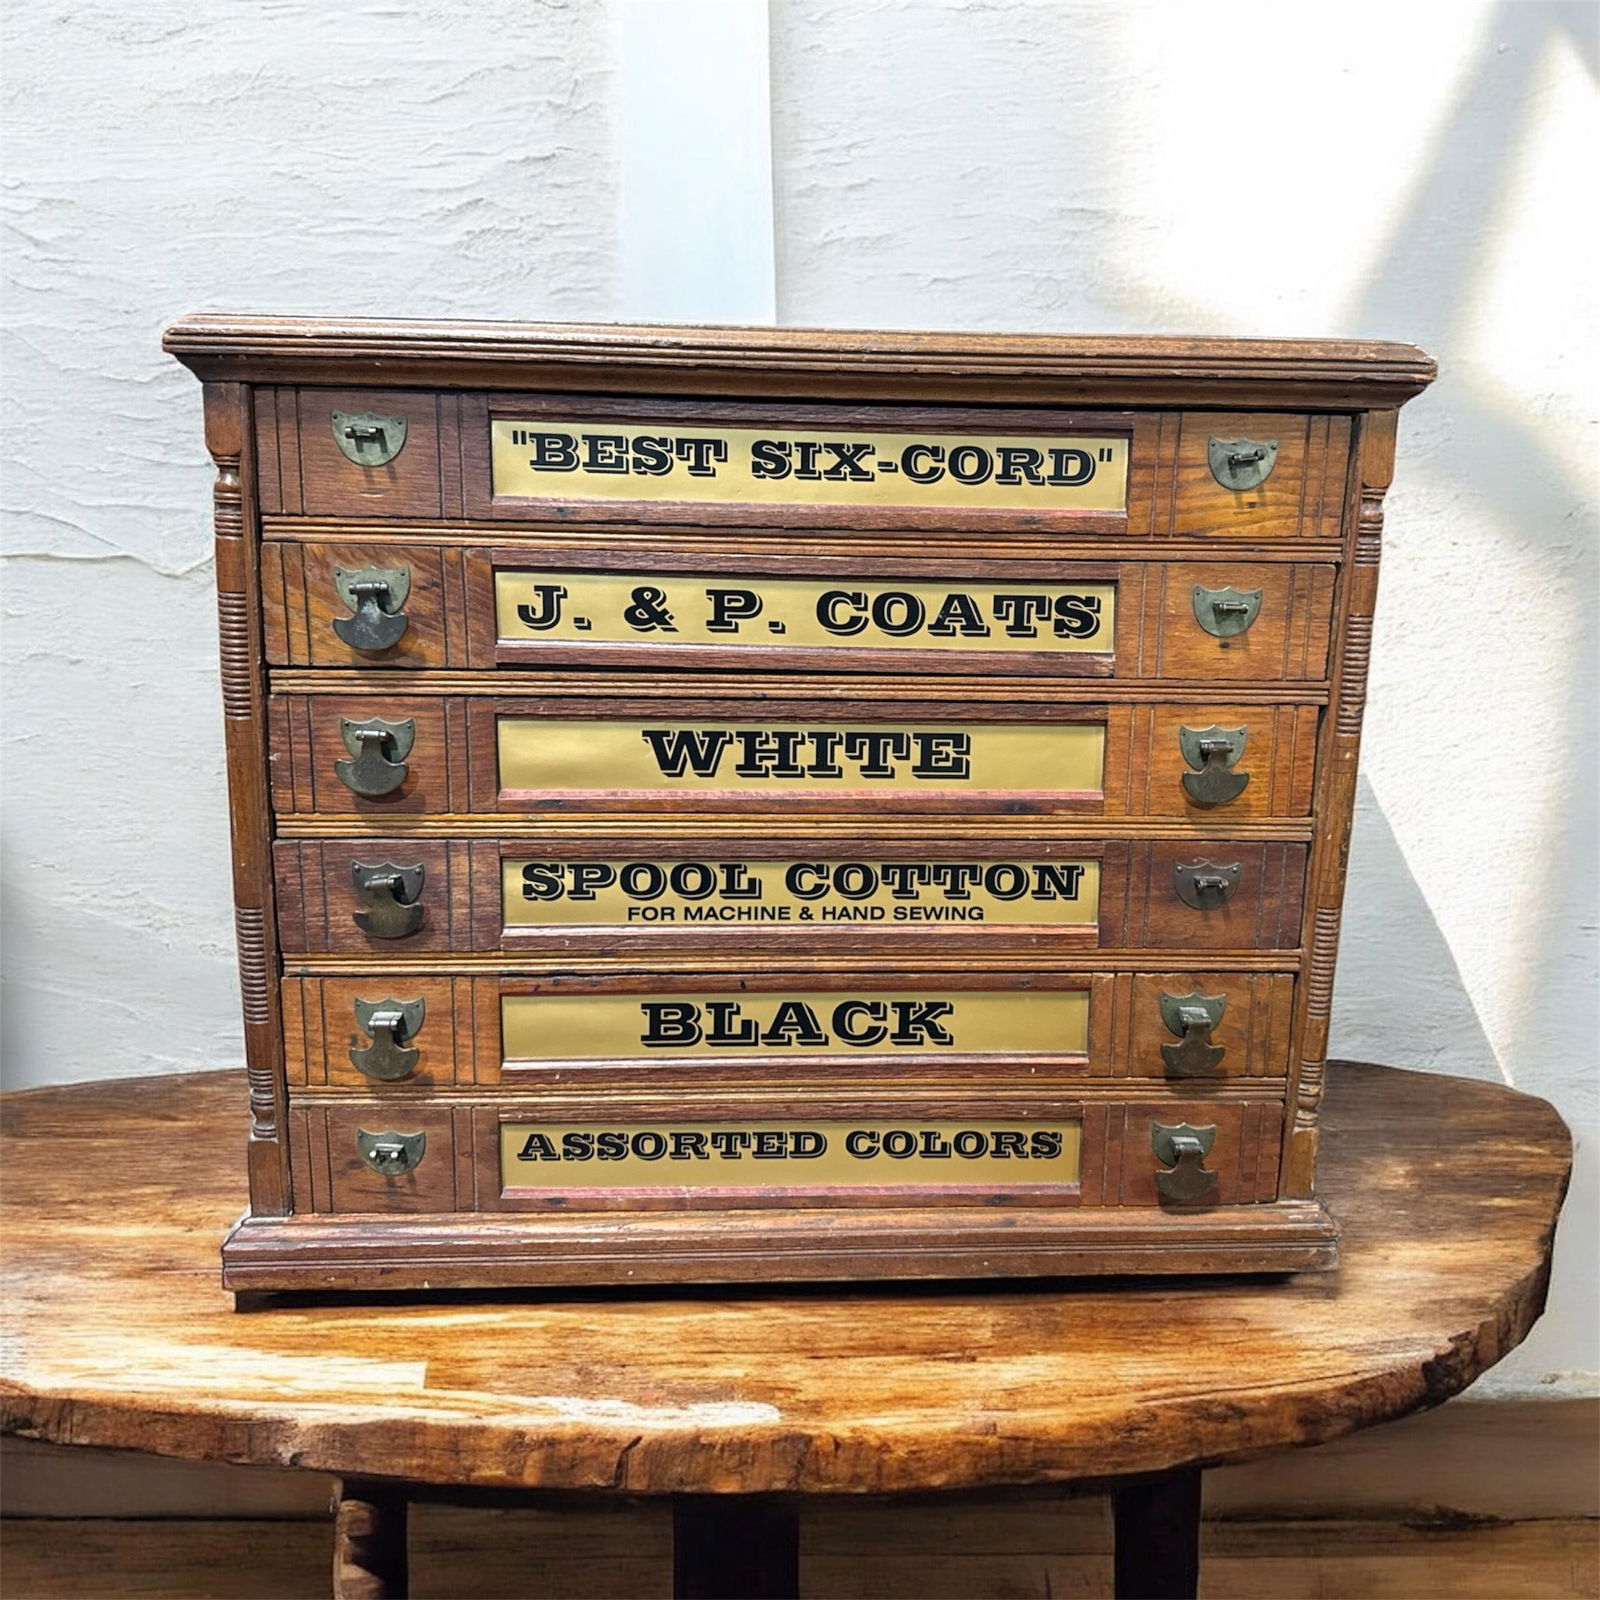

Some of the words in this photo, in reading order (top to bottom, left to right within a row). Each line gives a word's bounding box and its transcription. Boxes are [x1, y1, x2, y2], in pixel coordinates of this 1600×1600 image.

[512, 430, 728, 478] "BEST
[751, 439, 1113, 487] SIX-CORD"
[517, 585, 592, 631] J.
[623, 586, 679, 633] &
[705, 589, 786, 634] P.
[816, 590, 1102, 640] COATS
[641, 729, 971, 780] WHITE
[522, 862, 763, 902] SPOOL
[785, 862, 1086, 902] COTTON
[627, 906, 676, 921] FOR
[684, 906, 791, 921] MACHINE
[798, 906, 814, 921] &
[822, 906, 886, 921] HAND
[893, 906, 985, 921] SEWING
[640, 1000, 954, 1048] BLACK
[516, 1131, 828, 1162] ASSORTED
[845, 1130, 1063, 1160] COLORS
